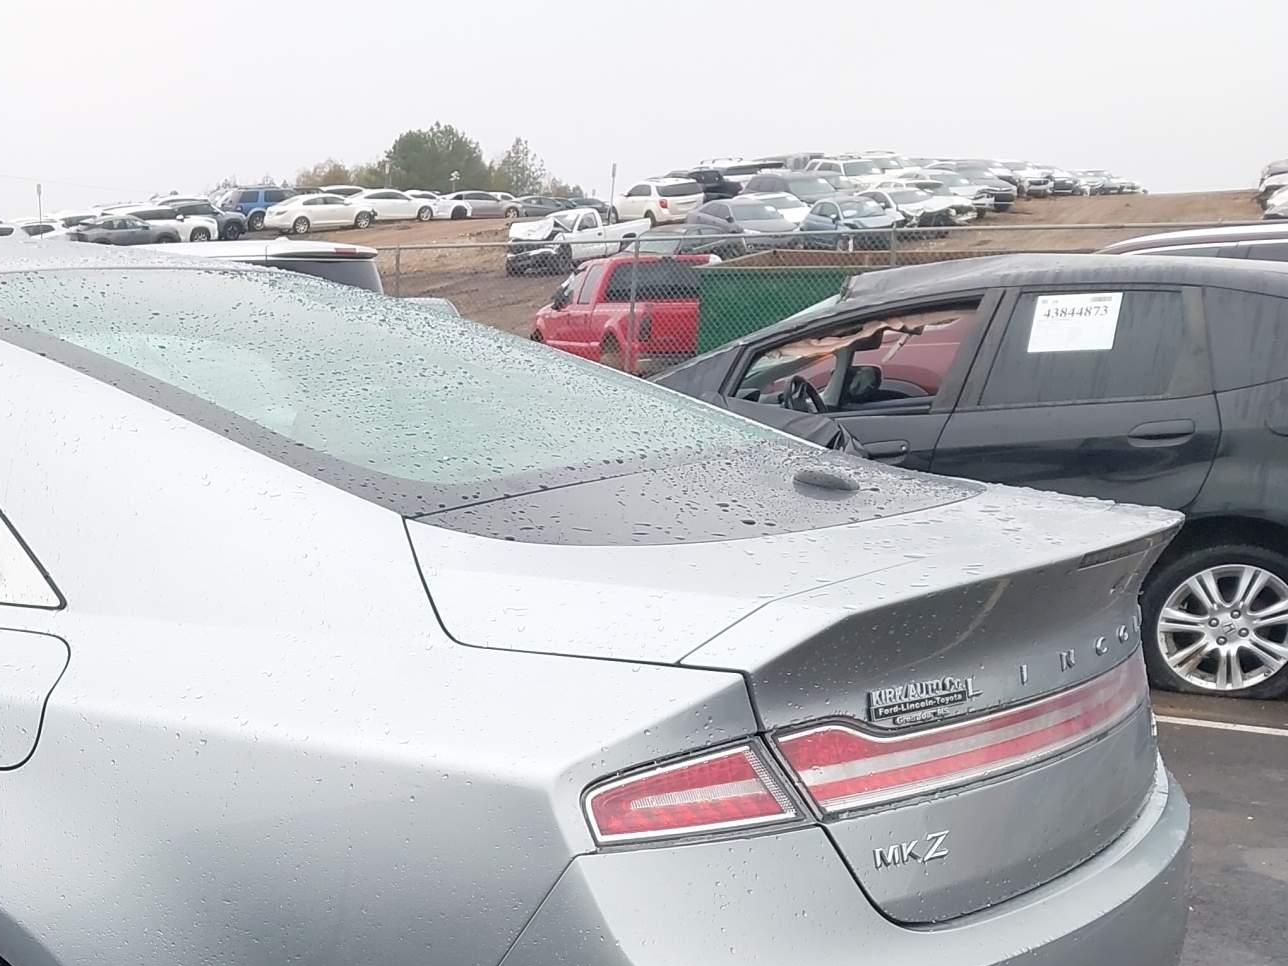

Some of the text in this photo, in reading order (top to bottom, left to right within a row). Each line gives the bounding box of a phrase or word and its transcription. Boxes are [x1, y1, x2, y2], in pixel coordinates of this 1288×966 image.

[1043, 305, 1109, 318] 43844873
[872, 684, 907, 706] KIRK
[907, 679, 944, 701] AUTO
[873, 830, 950, 869] MKZ
